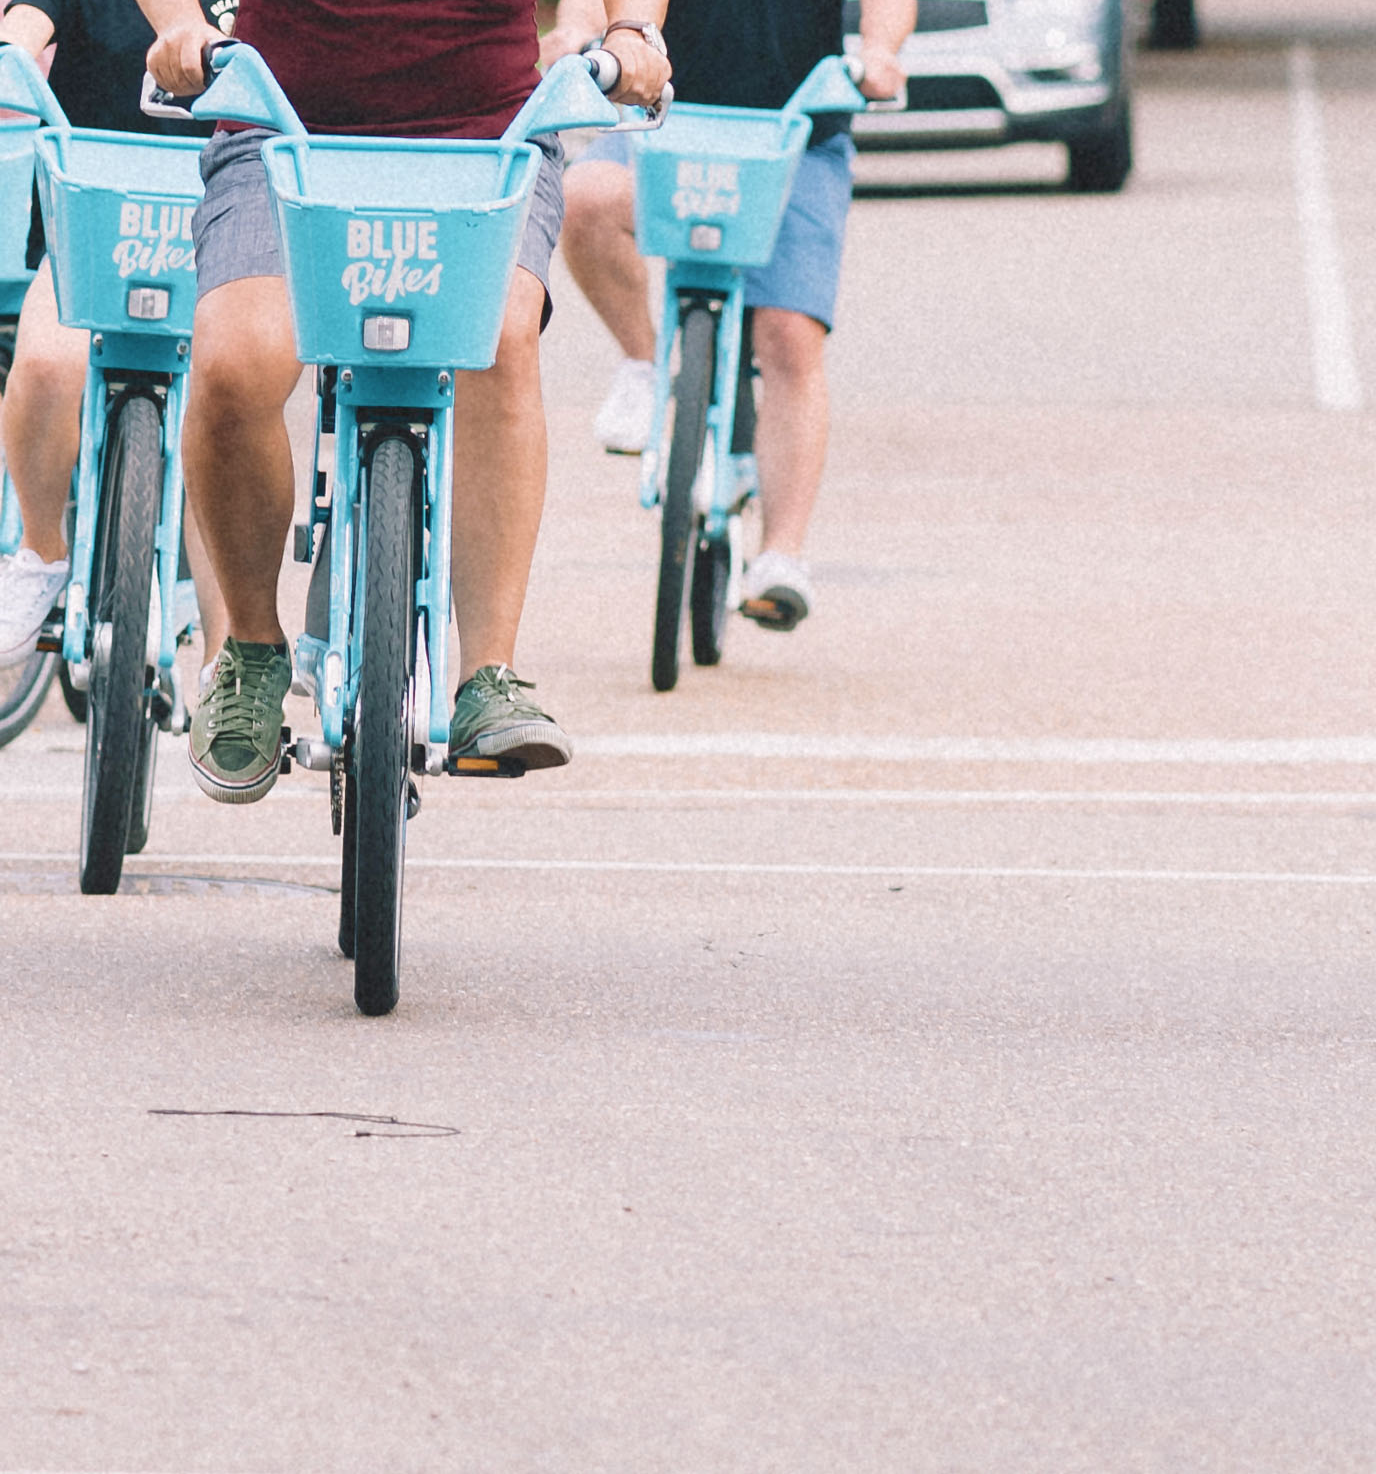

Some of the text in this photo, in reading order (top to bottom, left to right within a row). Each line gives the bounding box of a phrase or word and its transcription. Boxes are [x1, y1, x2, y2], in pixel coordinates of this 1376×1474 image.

[677, 161, 739, 190] BLUE
[112, 233, 196, 278] Bikes
[347, 220, 438, 259] BLUE
[341, 257, 443, 306] Bikes
